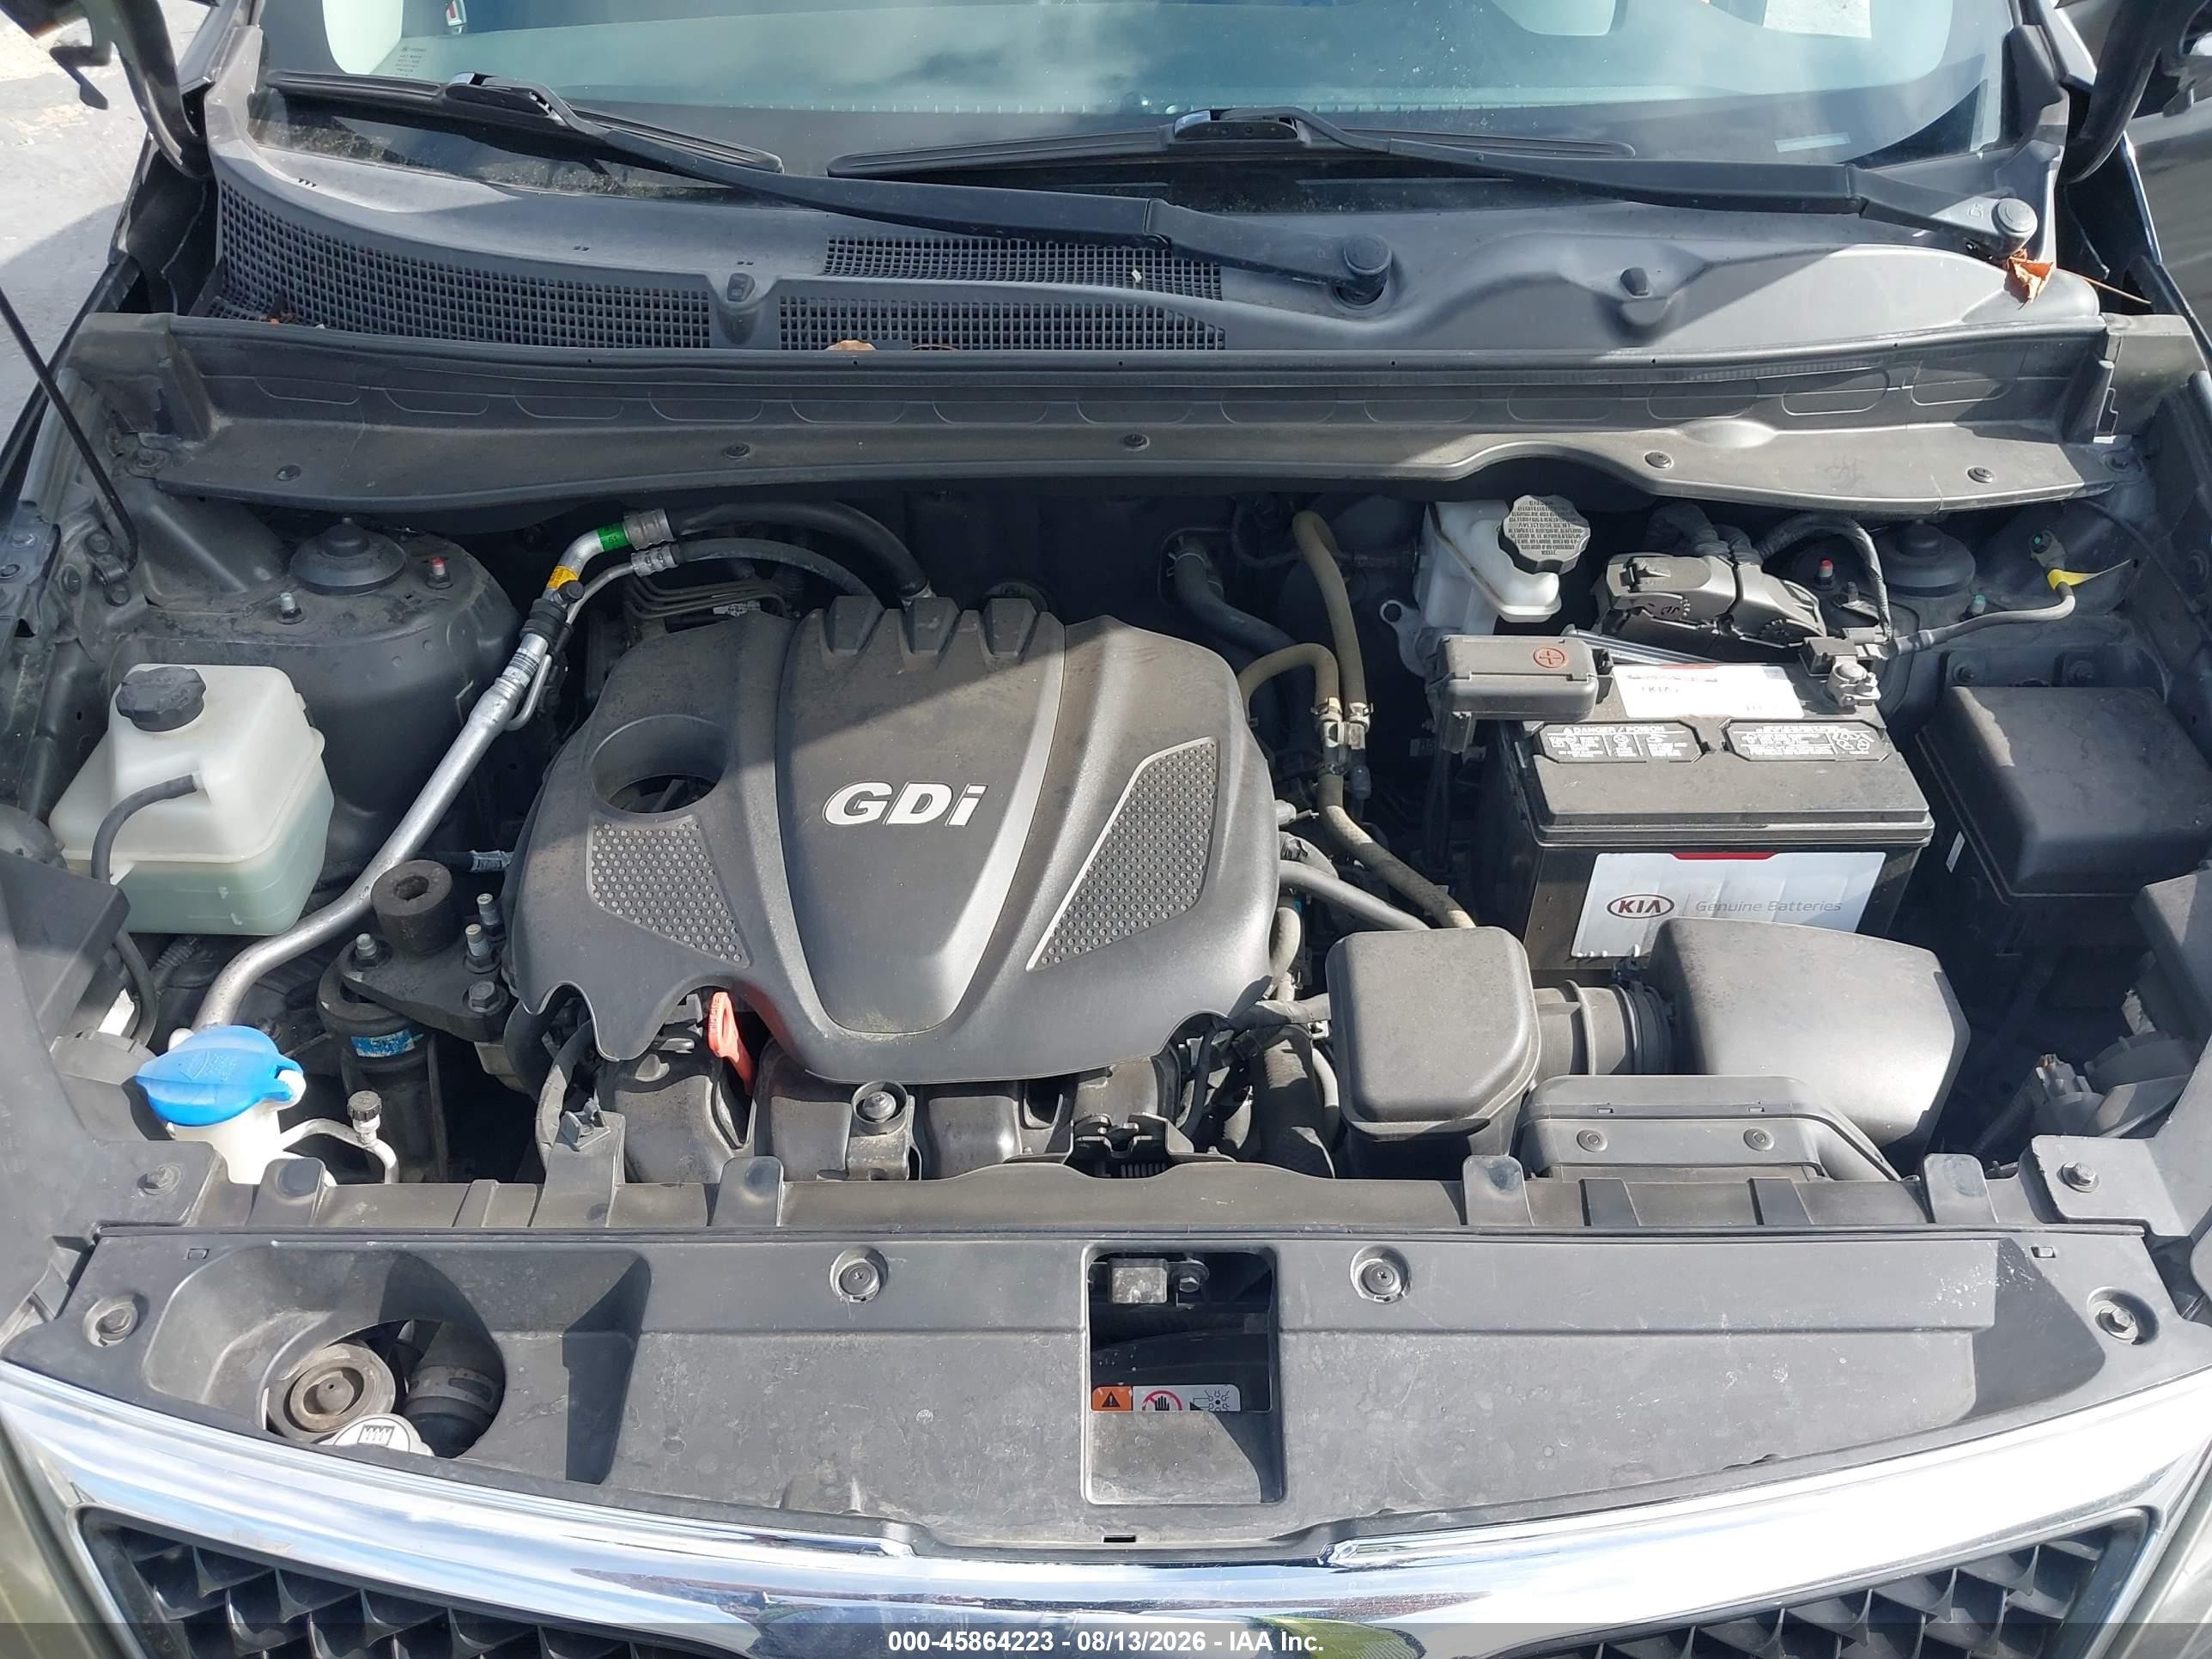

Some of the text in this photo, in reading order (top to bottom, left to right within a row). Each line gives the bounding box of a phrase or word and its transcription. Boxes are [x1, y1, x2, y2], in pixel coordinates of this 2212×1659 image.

[823, 781, 988, 827] GDi
[1695, 900, 1844, 912] Genuine Batteries
